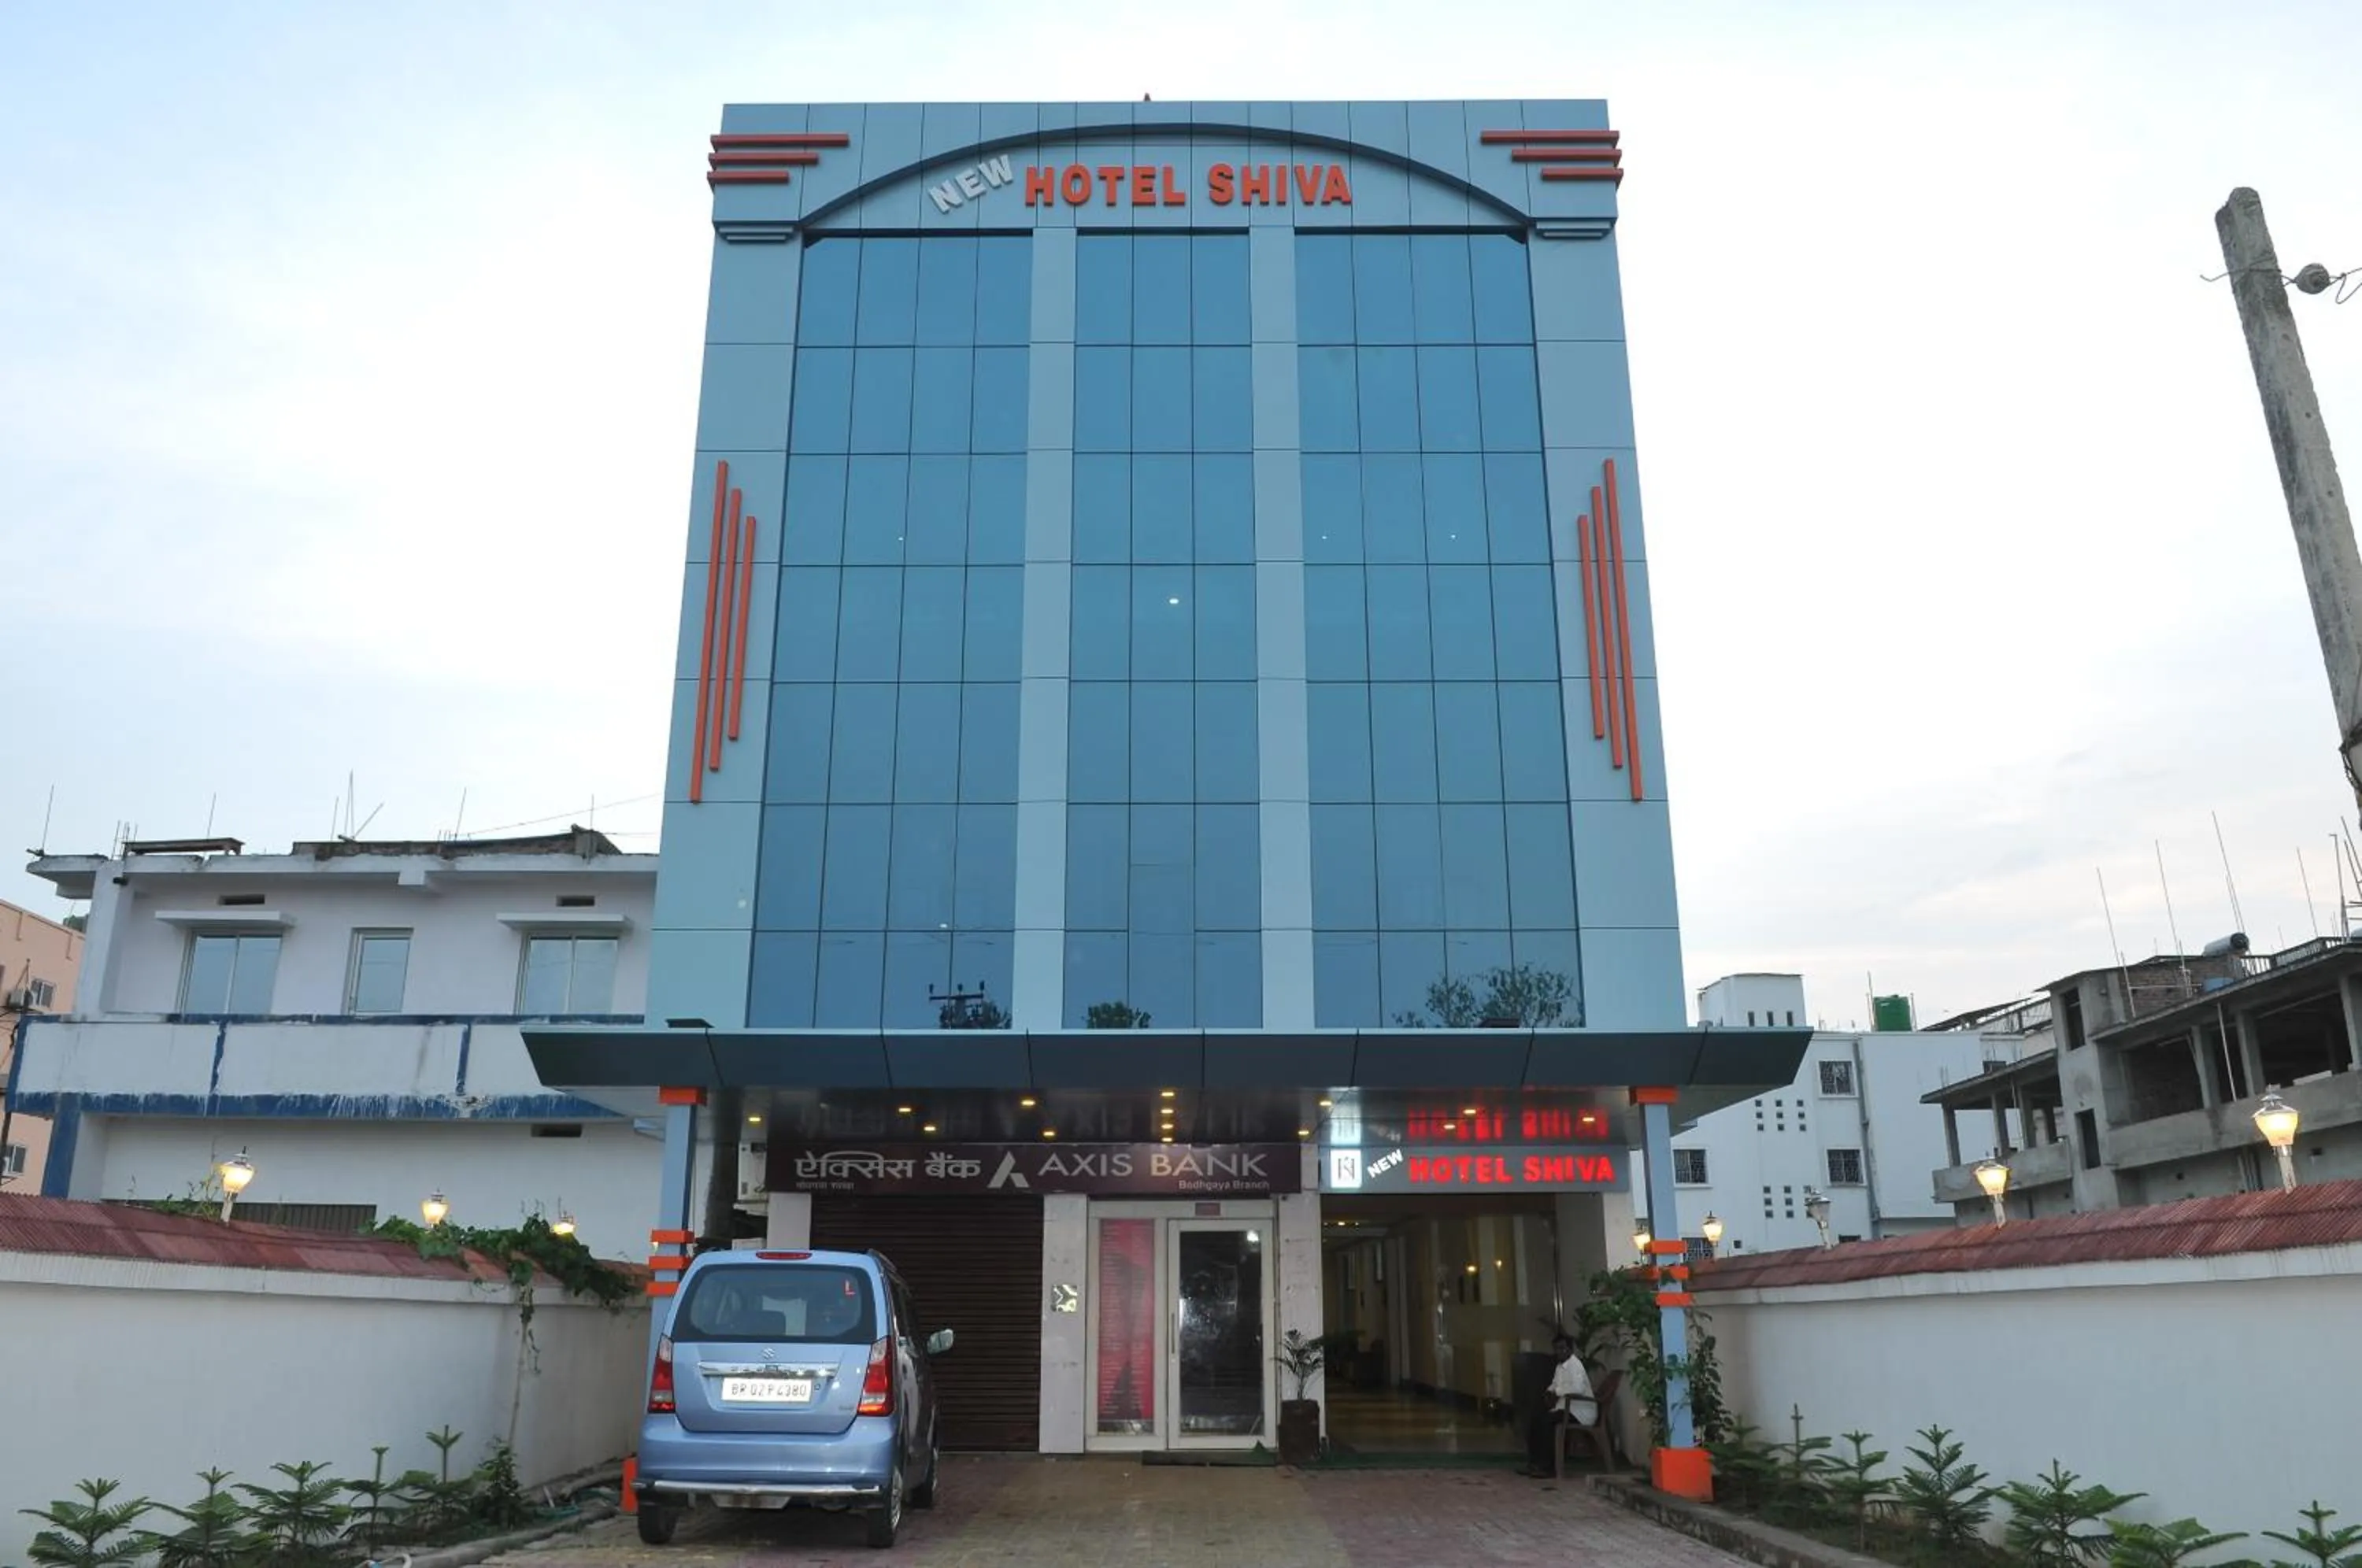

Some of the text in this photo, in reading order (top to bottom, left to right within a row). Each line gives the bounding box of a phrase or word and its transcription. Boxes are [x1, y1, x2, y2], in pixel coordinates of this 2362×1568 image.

[927, 154, 1353, 214] NEW HOTEL SHIVA
[794, 1150, 982, 1179] ऐक्सिस बैंक
[1037, 1152, 1268, 1177] AXIS BANK
[1366, 1148, 1616, 1184] NEW HOTEL SHIVA
[1179, 1180, 1270, 1191] Bodhgaya Branch
